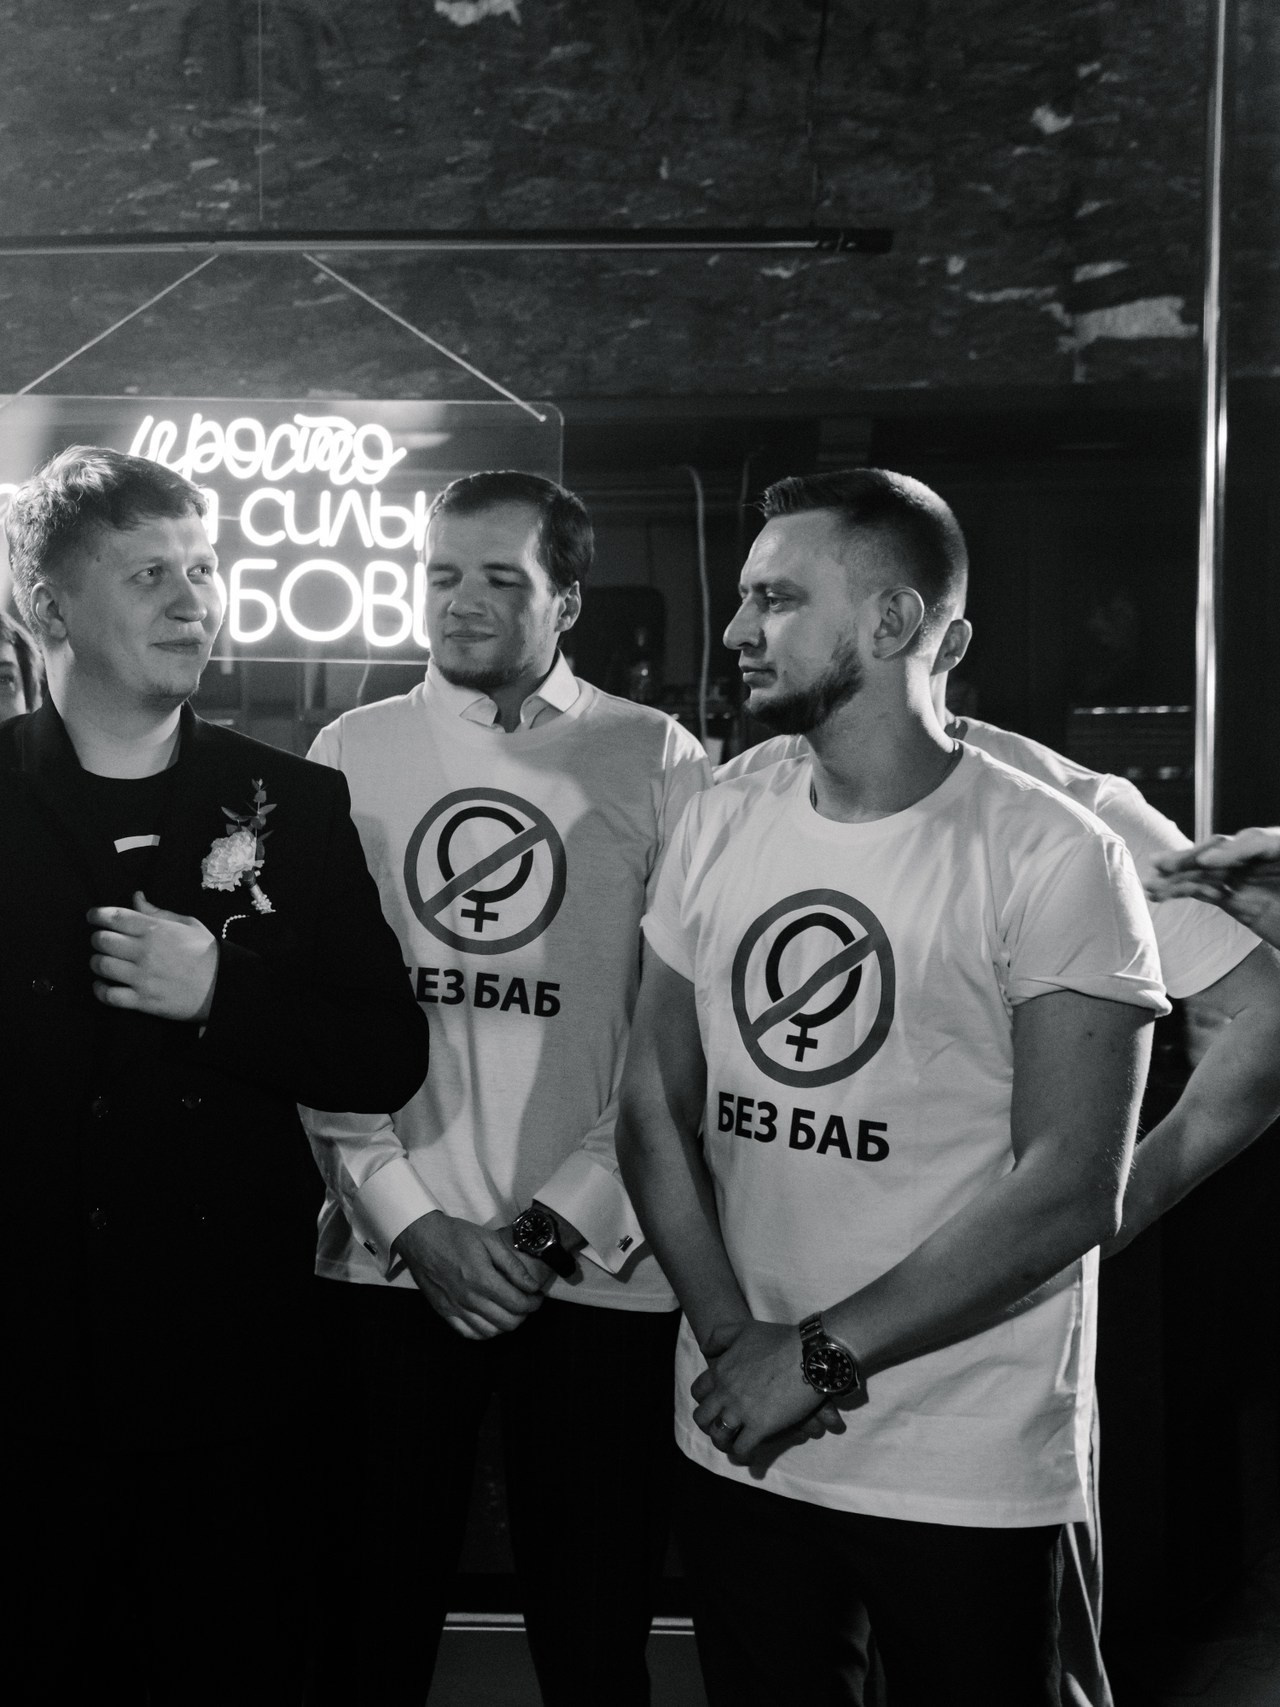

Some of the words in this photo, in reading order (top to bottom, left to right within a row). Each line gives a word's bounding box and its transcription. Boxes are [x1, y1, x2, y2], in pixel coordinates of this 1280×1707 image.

[473, 971, 561, 1018] БАБ
[717, 1091, 778, 1143] БЕЗ
[788, 1107, 890, 1163] БАБ
